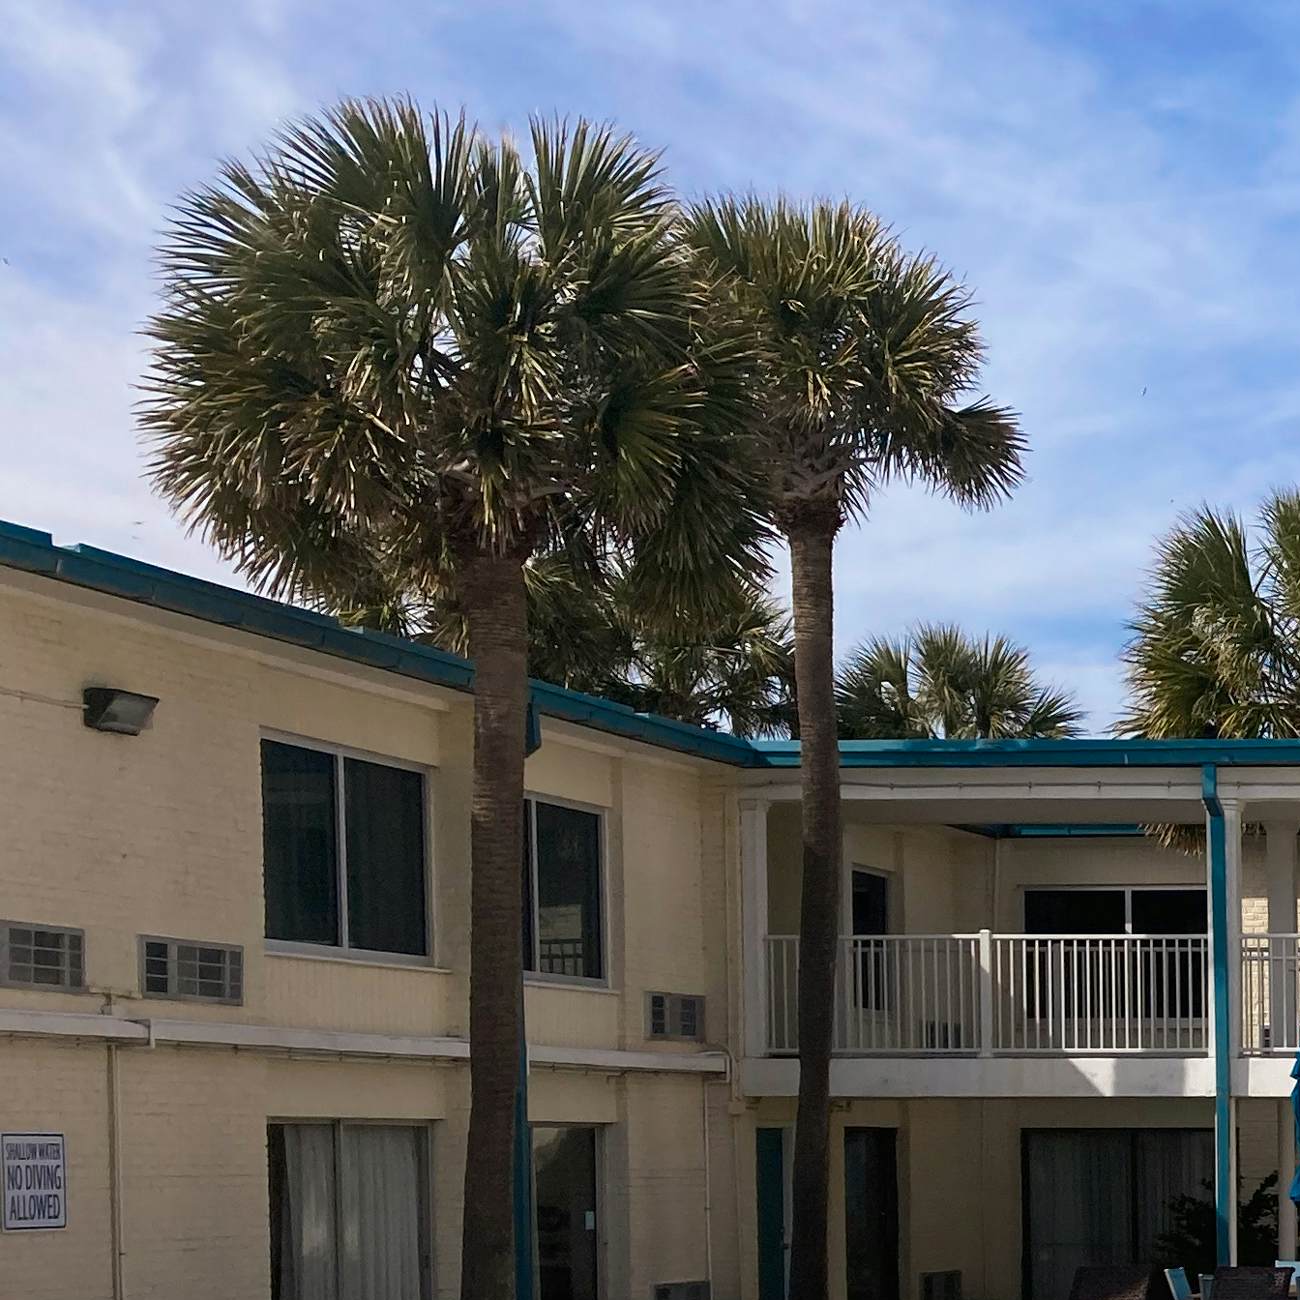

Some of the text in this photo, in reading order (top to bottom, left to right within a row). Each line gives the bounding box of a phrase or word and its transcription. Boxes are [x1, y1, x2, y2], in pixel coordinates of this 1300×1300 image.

[7, 1165, 62, 1190] NO DIVING
[10, 1195, 60, 1220] ALLOWED
